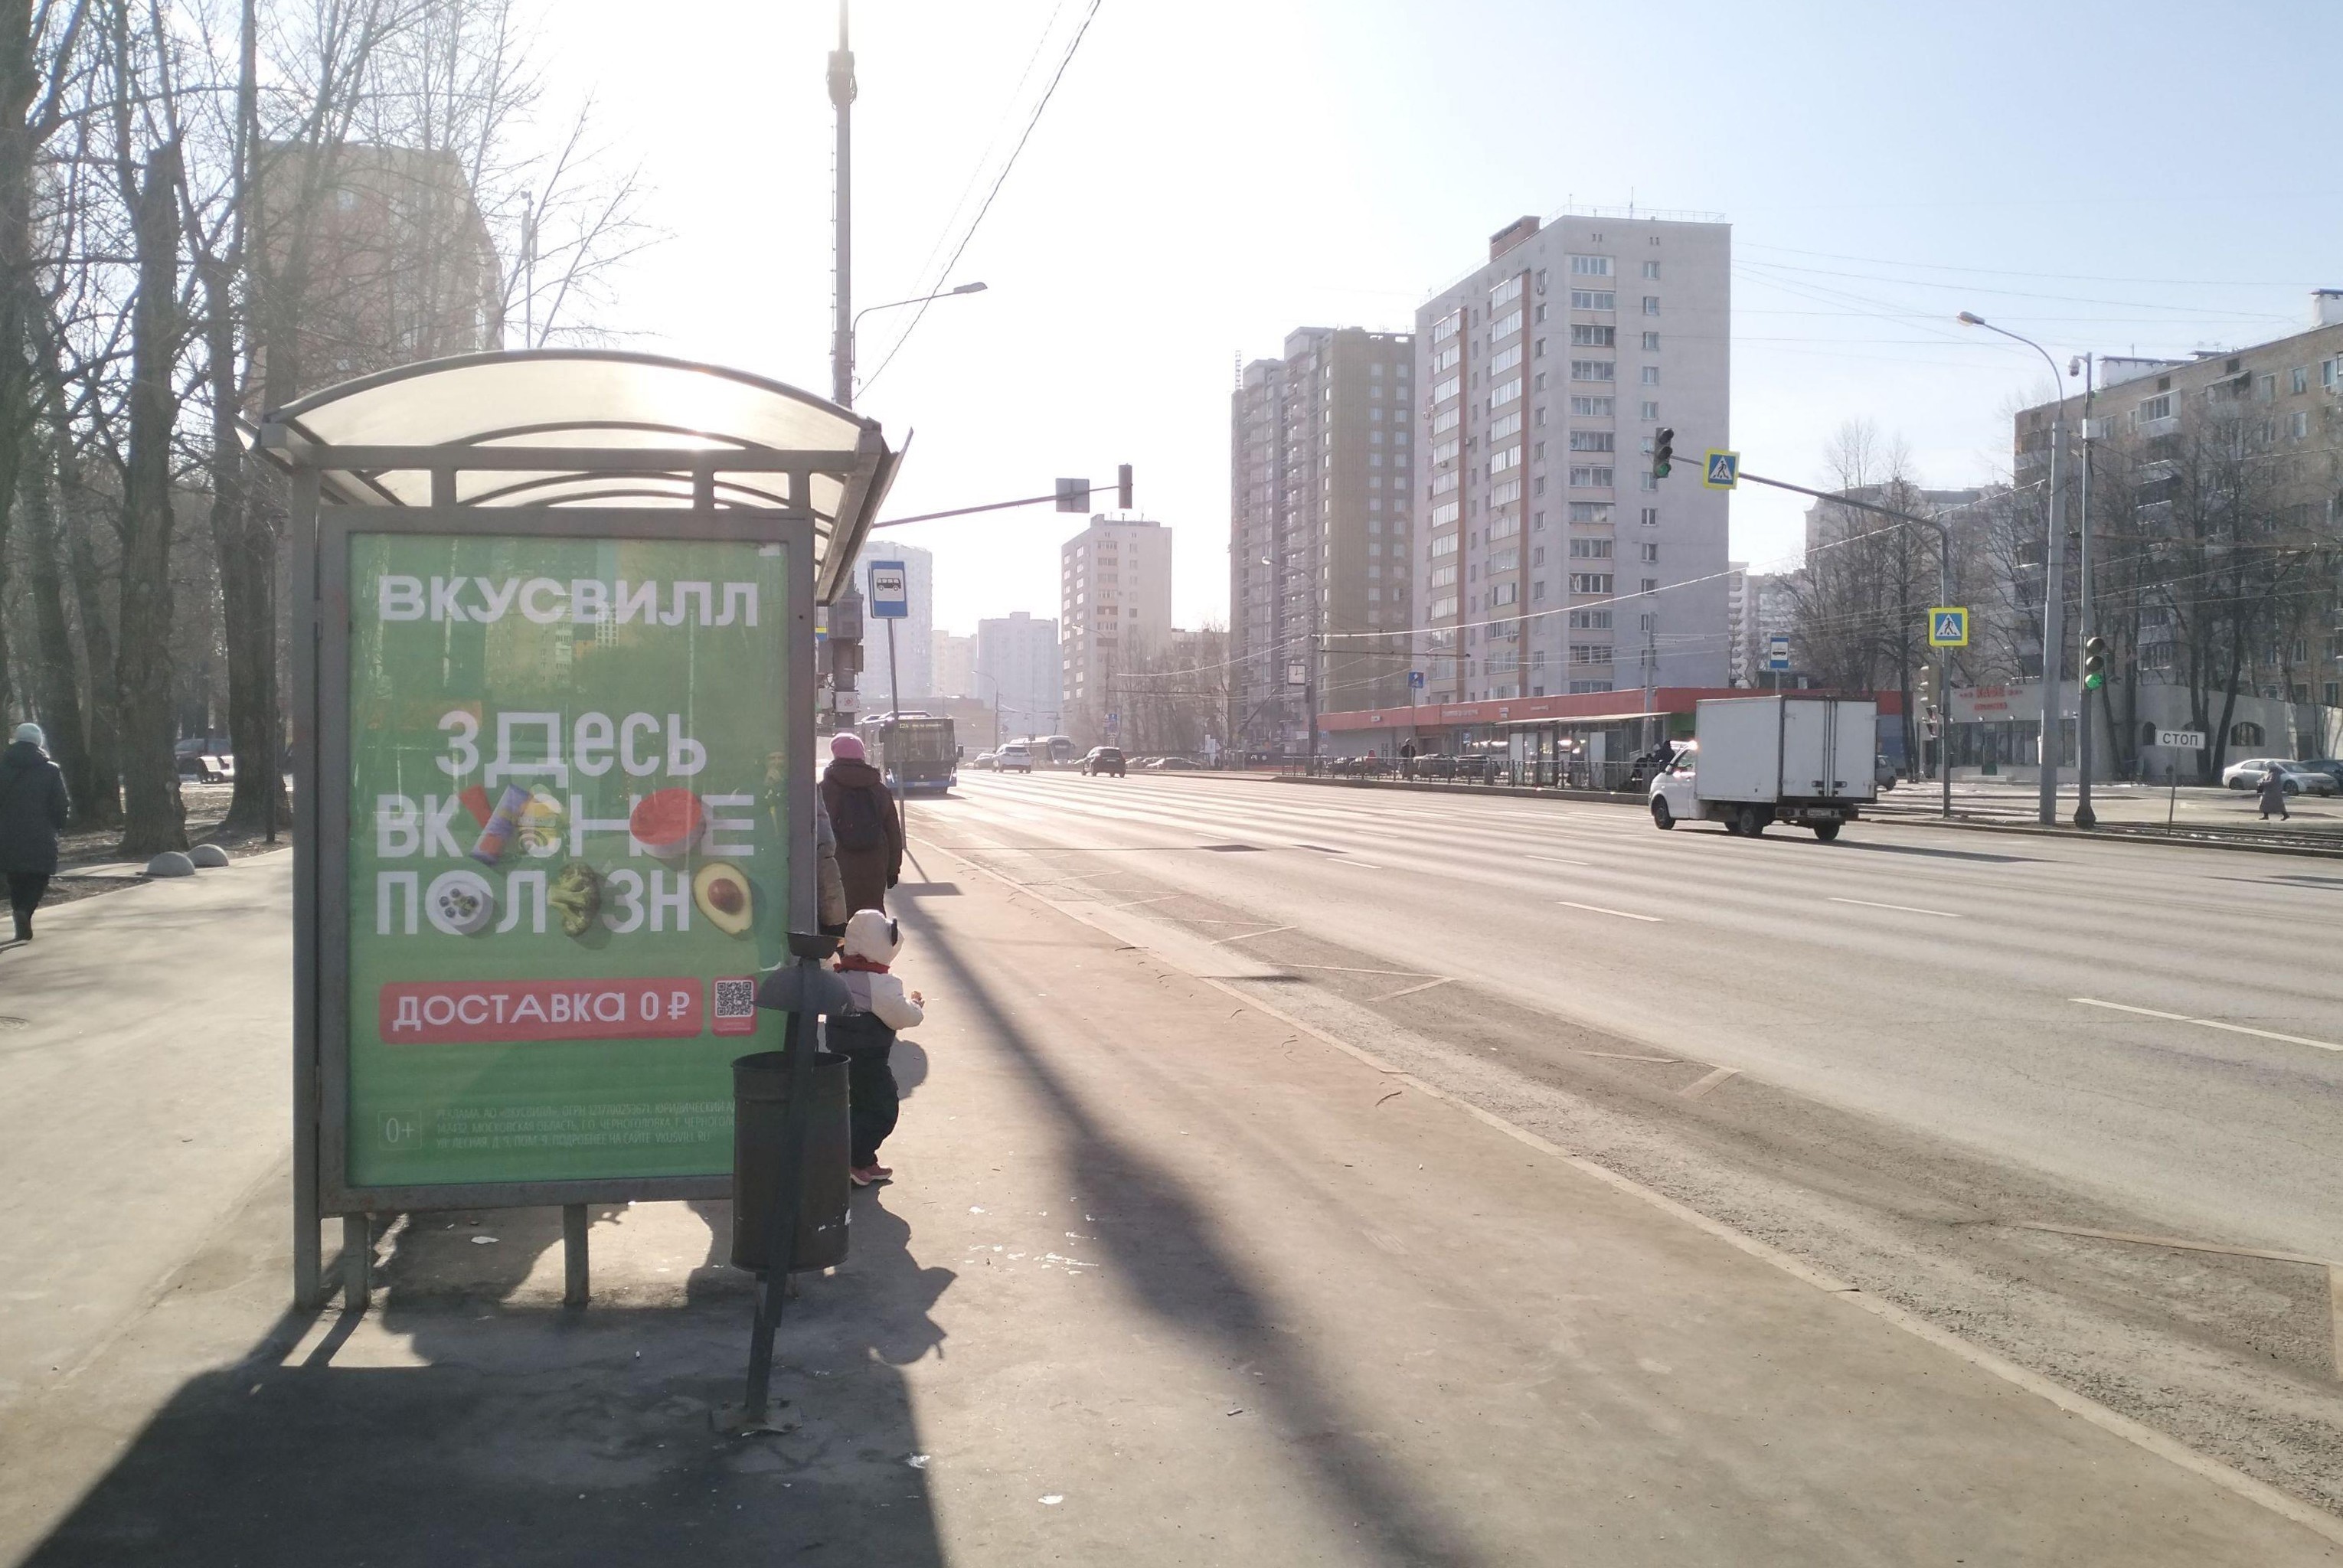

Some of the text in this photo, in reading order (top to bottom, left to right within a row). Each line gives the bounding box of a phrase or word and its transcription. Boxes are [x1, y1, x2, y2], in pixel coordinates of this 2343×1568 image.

[379, 575, 758, 627] ВКУСВИЛЛ
[2162, 732, 2198, 746] СТОП
[376, 789, 755, 861] ВКСНЕ
[376, 864, 753, 936] ПОЛЗН
[640, 991, 659, 1021] 0
[385, 1117, 415, 1144] 0+
